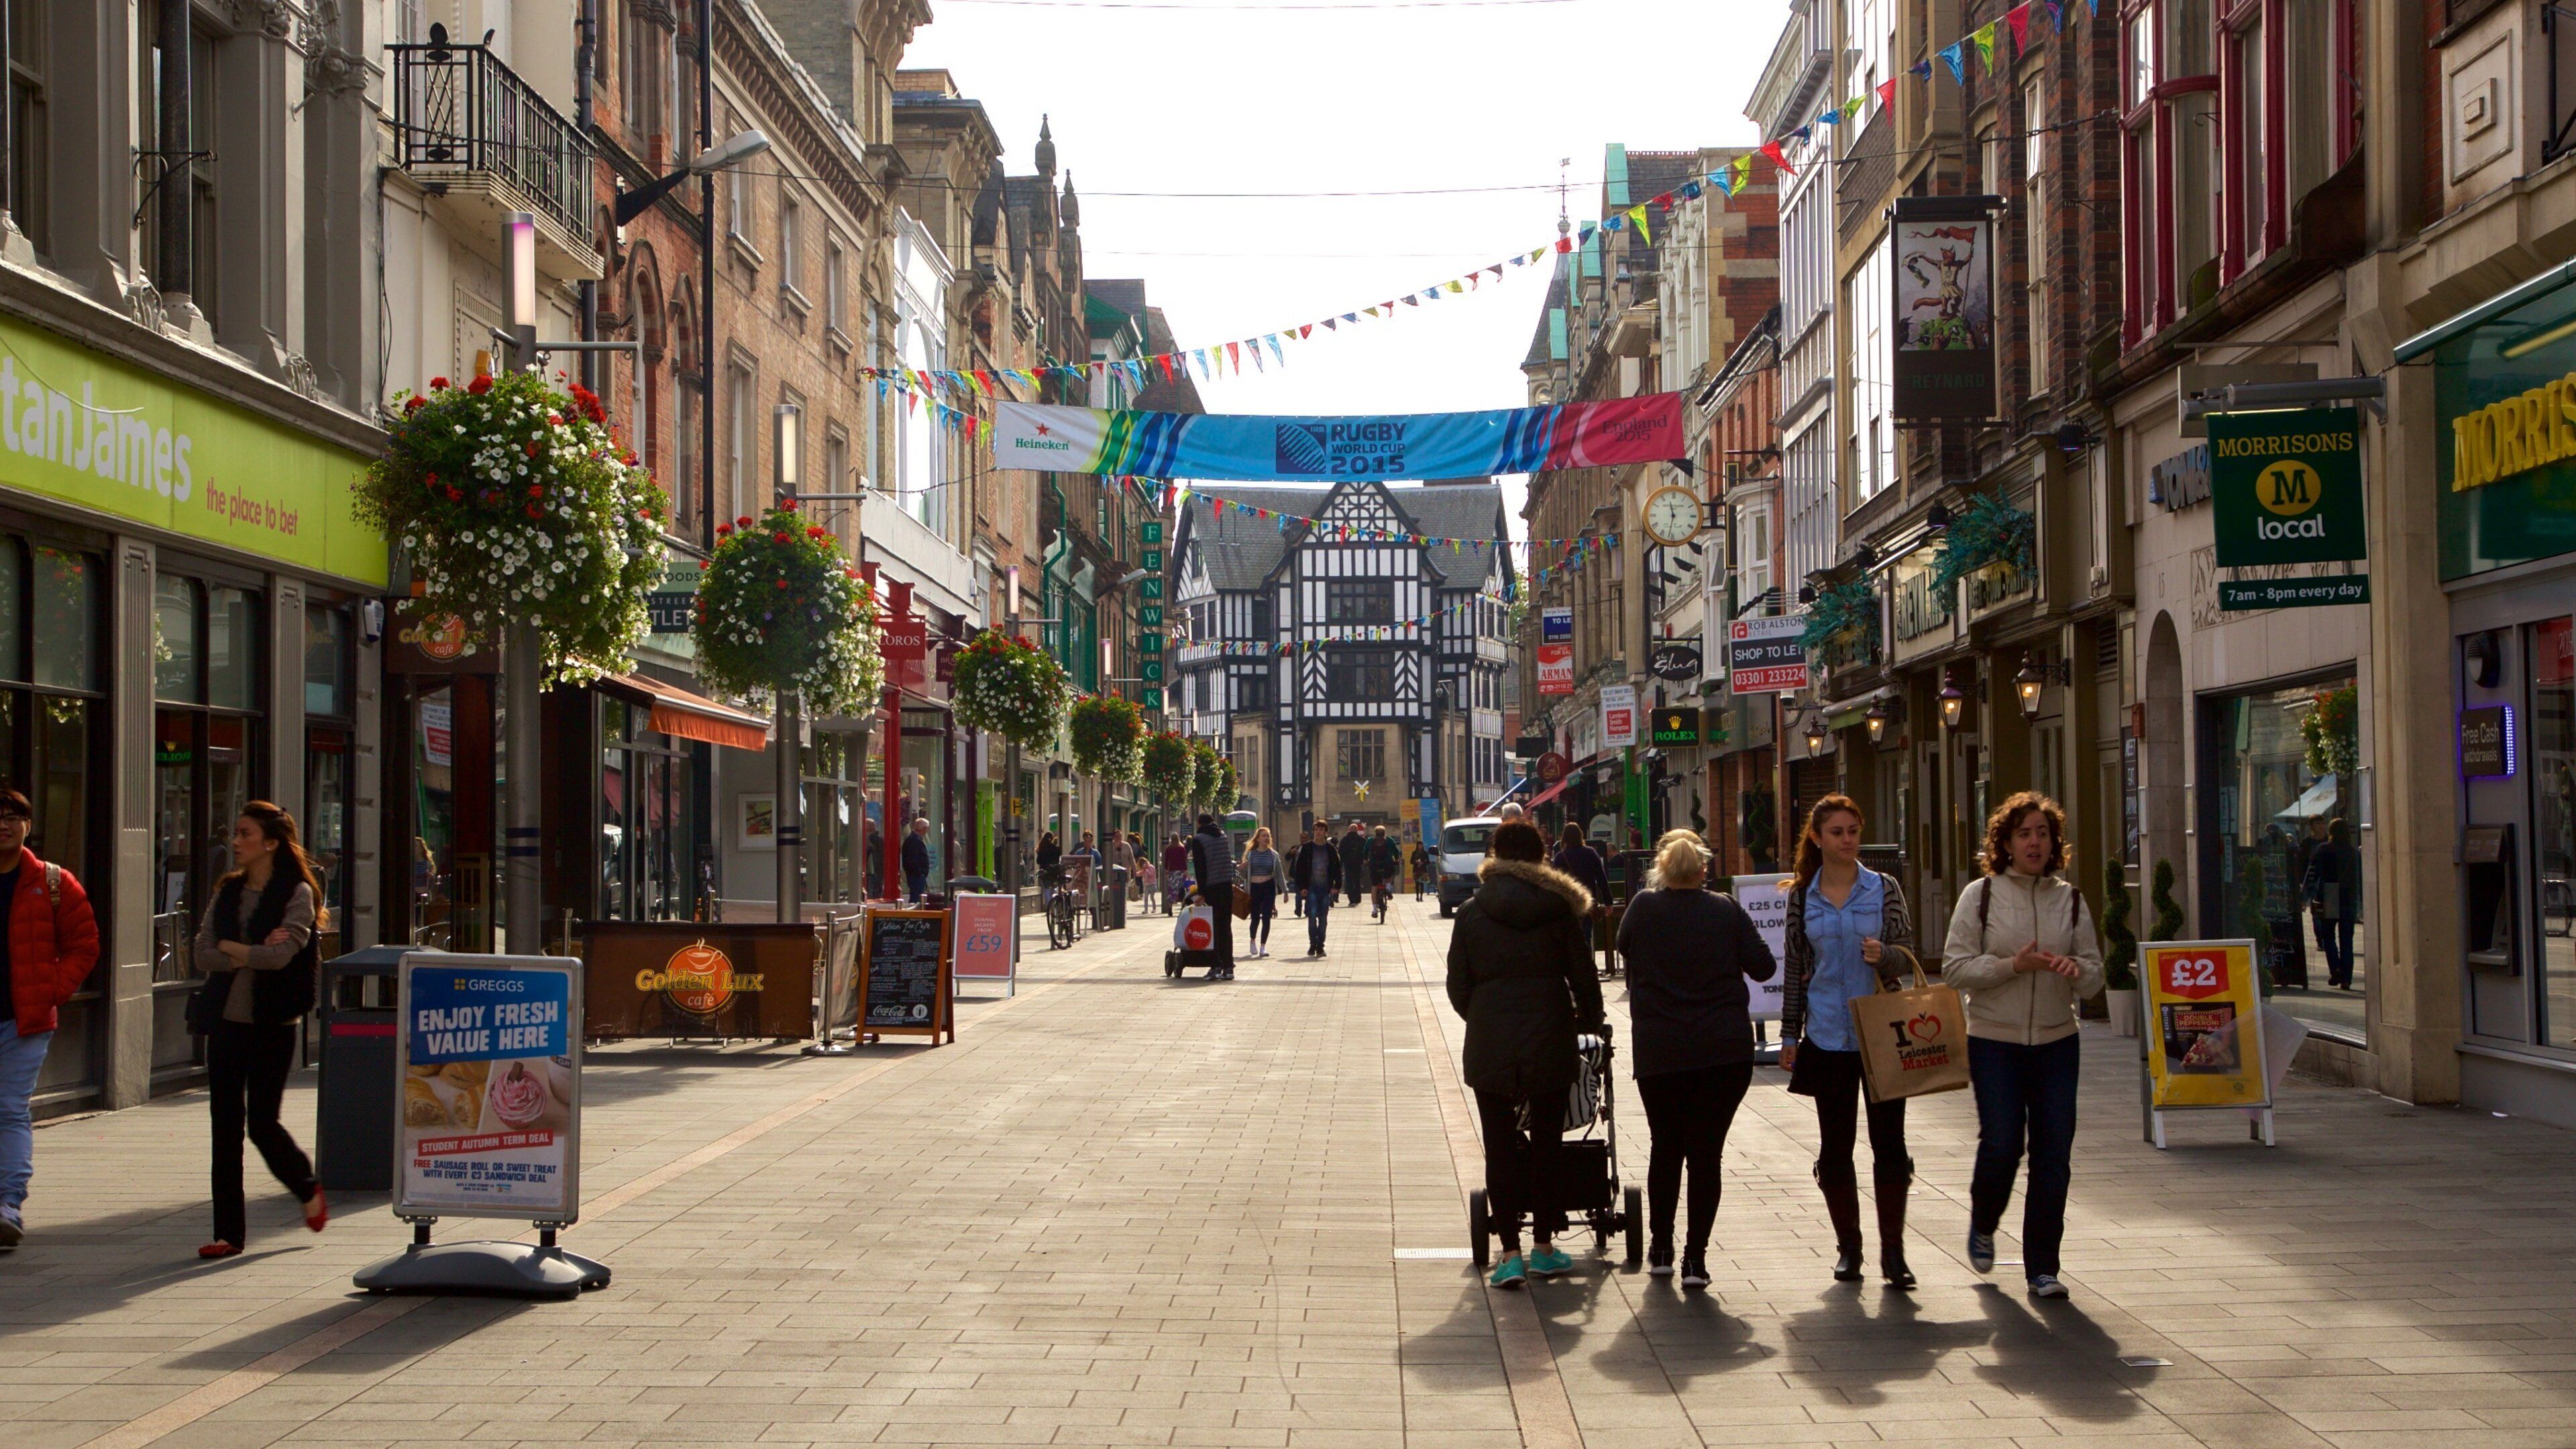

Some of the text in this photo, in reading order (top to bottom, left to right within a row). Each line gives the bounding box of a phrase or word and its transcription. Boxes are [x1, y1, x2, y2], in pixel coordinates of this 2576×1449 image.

[1912, 374, 1985, 388] REYNARD
[1331, 423, 1407, 441] RUGBY
[1601, 414, 1667, 434] England
[1015, 438, 1069, 450] Heineken
[1615, 429, 1651, 442] 2015
[1332, 443, 1405, 453] WORLD CUP
[2218, 433, 2353, 458] MORRISONS
[1331, 455, 1405, 474] 2015
[2270, 469, 2310, 506] M
[207, 476, 298, 535] the place to bet
[2257, 513, 2325, 540] local
[2228, 589, 2257, 601] 7am
[2267, 587, 2296, 602] 8pm
[2299, 587, 2336, 599] every
[2339, 583, 2363, 598] day
[1144, 525, 1161, 706] FENWICK
[1748, 616, 1804, 631] ROB ALSTON
[435, 644, 453, 655] café
[1735, 648, 1763, 661] SHOP
[1766, 646, 1780, 657] TO
[1735, 668, 1805, 685] 03301 233224
[1654, 731, 1697, 741] ROLEX
[2462, 722, 2500, 744] Free Cash
[2464, 747, 2498, 763] withdrawals
[1749, 902, 1770, 910] £25
[966, 935, 1002, 952] £59
[635, 968, 764, 991] Golden Lux
[2171, 959, 2216, 987] £2
[469, 979, 524, 992] GREGGS
[688, 993, 714, 1009] café
[419, 1001, 559, 1032] ENJOY FRESH
[427, 1026, 549, 1056] VALUE HERE
[1889, 1020, 1913, 1048] I
[1898, 1044, 1947, 1059] Leicester
[1900, 1055, 1949, 1071] Market
[422, 1133, 549, 1152] STUDENT AUTUMN TERM DEAL
[414, 1159, 431, 1168] FREE
[433, 1161, 468, 1170] SAUSAGE
[492, 1163, 502, 1171] OR
[506, 1163, 530, 1173] SWEET
[533, 1165, 556, 1173] TREAT
[423, 1169, 442, 1177] WITH
[444, 1169, 468, 1179] EVERY
[485, 1173, 526, 1182] SANDWICH
[529, 1174, 547, 1183] DEAL
